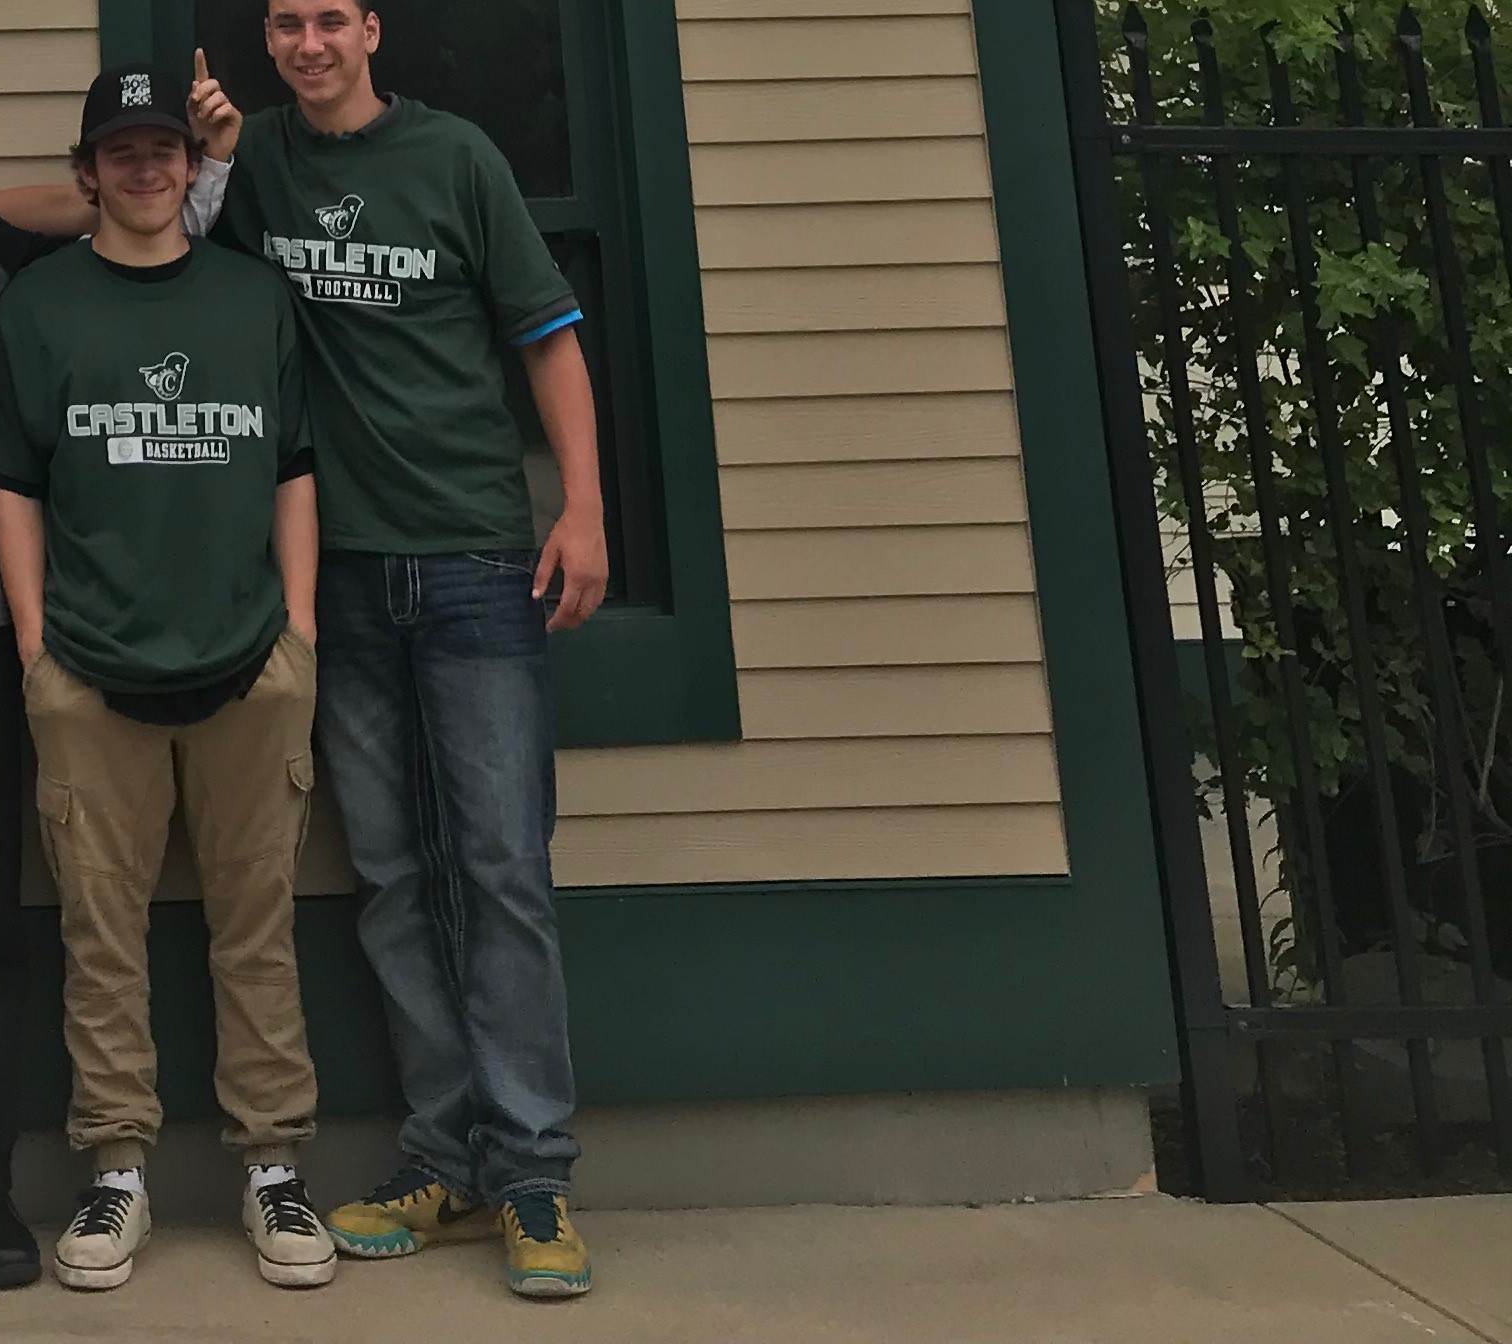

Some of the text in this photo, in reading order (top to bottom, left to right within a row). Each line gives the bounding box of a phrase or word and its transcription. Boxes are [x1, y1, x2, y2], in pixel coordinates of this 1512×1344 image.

[316, 279, 393, 301] FOOTBALL
[67, 402, 265, 438] CASTLETON
[145, 441, 226, 459] BASKETBALL
